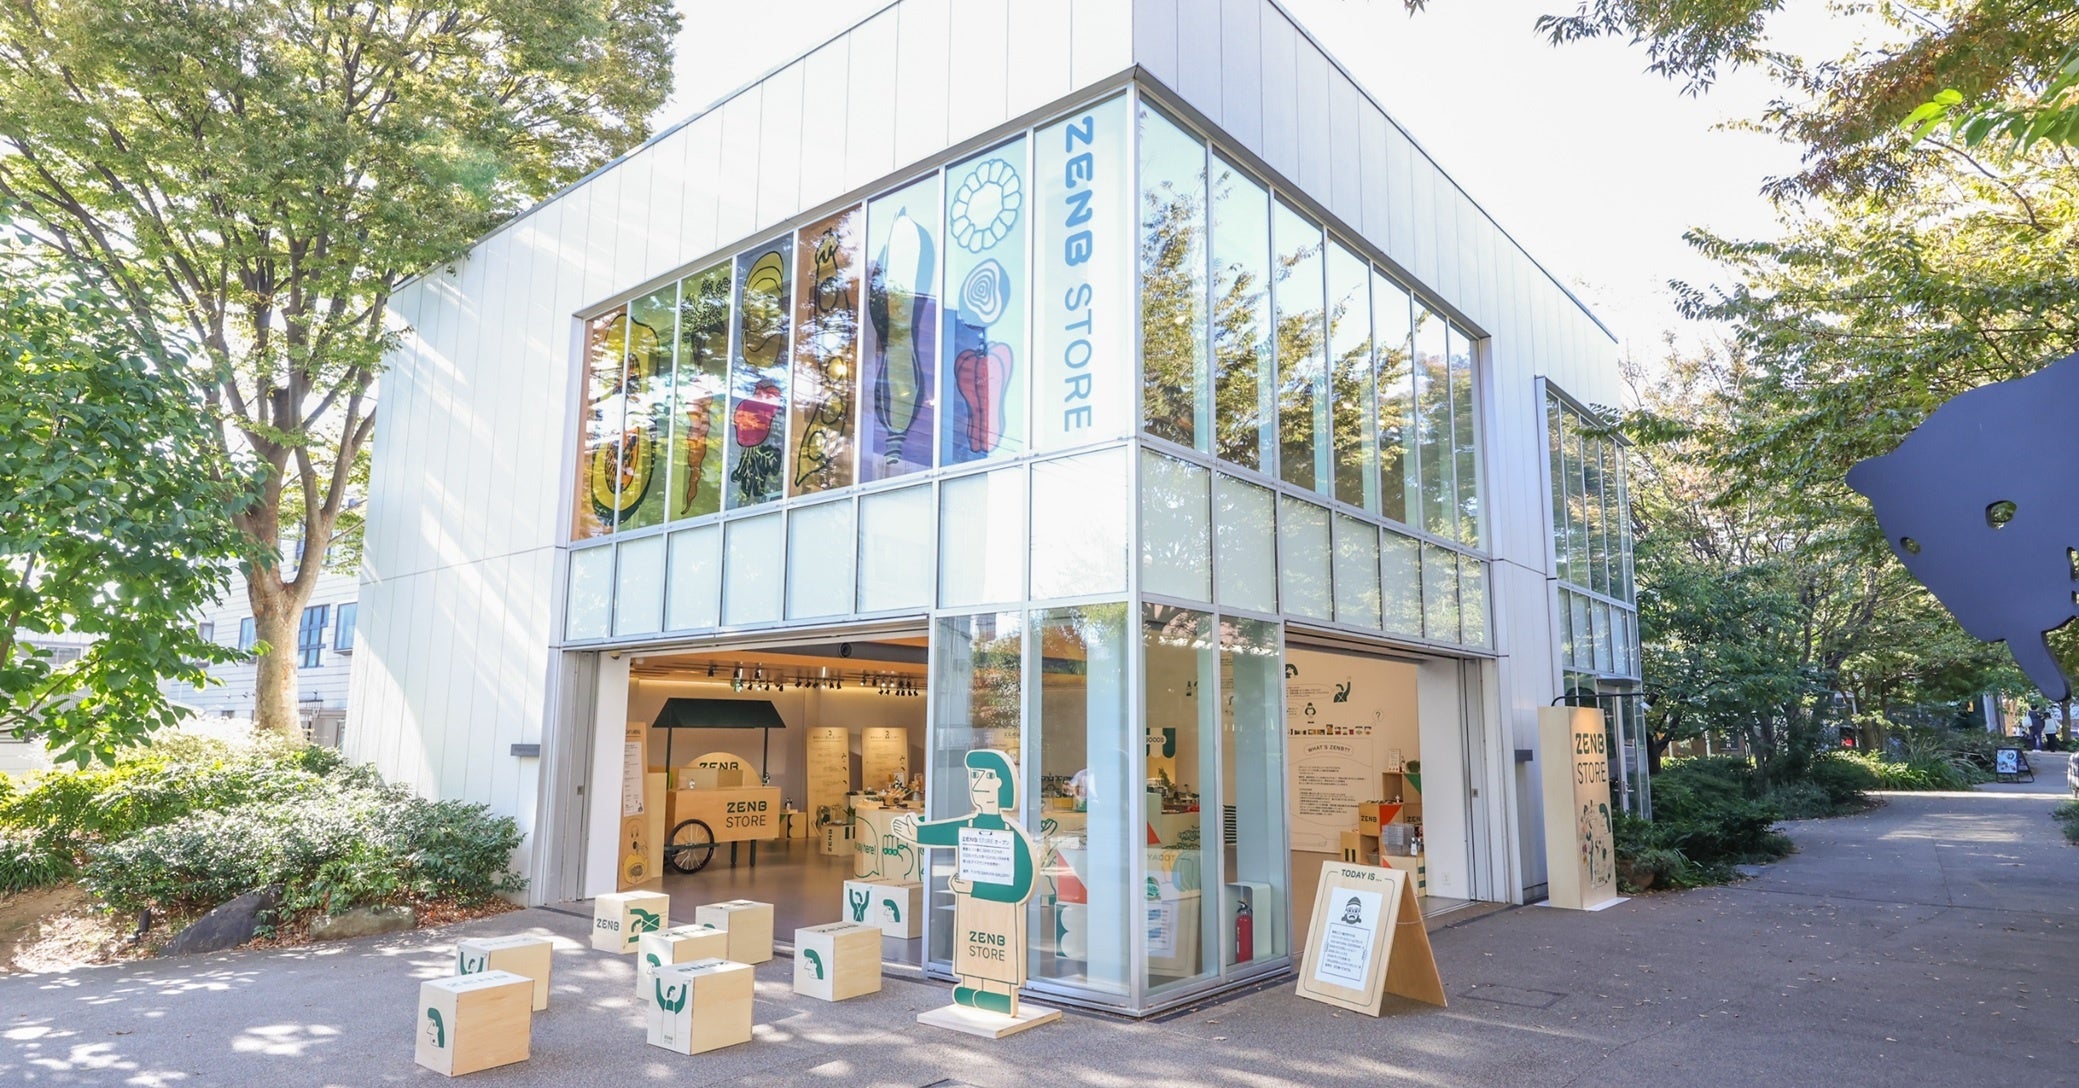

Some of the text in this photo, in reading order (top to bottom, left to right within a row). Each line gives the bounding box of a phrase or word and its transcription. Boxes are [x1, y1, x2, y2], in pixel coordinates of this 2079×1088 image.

[1064, 116, 1094, 432] ZENB STORE
[1575, 733, 1604, 754] ZENB
[1577, 761, 1607, 784] STORE
[726, 801, 767, 813] ZENB
[726, 814, 767, 828] STORE
[1360, 815, 1378, 823] ZENB
[1341, 869, 1367, 880] TODAY
[596, 918, 620, 932] ZENB
[969, 931, 1005, 946] ZENB
[969, 945, 1005, 962] STORE
